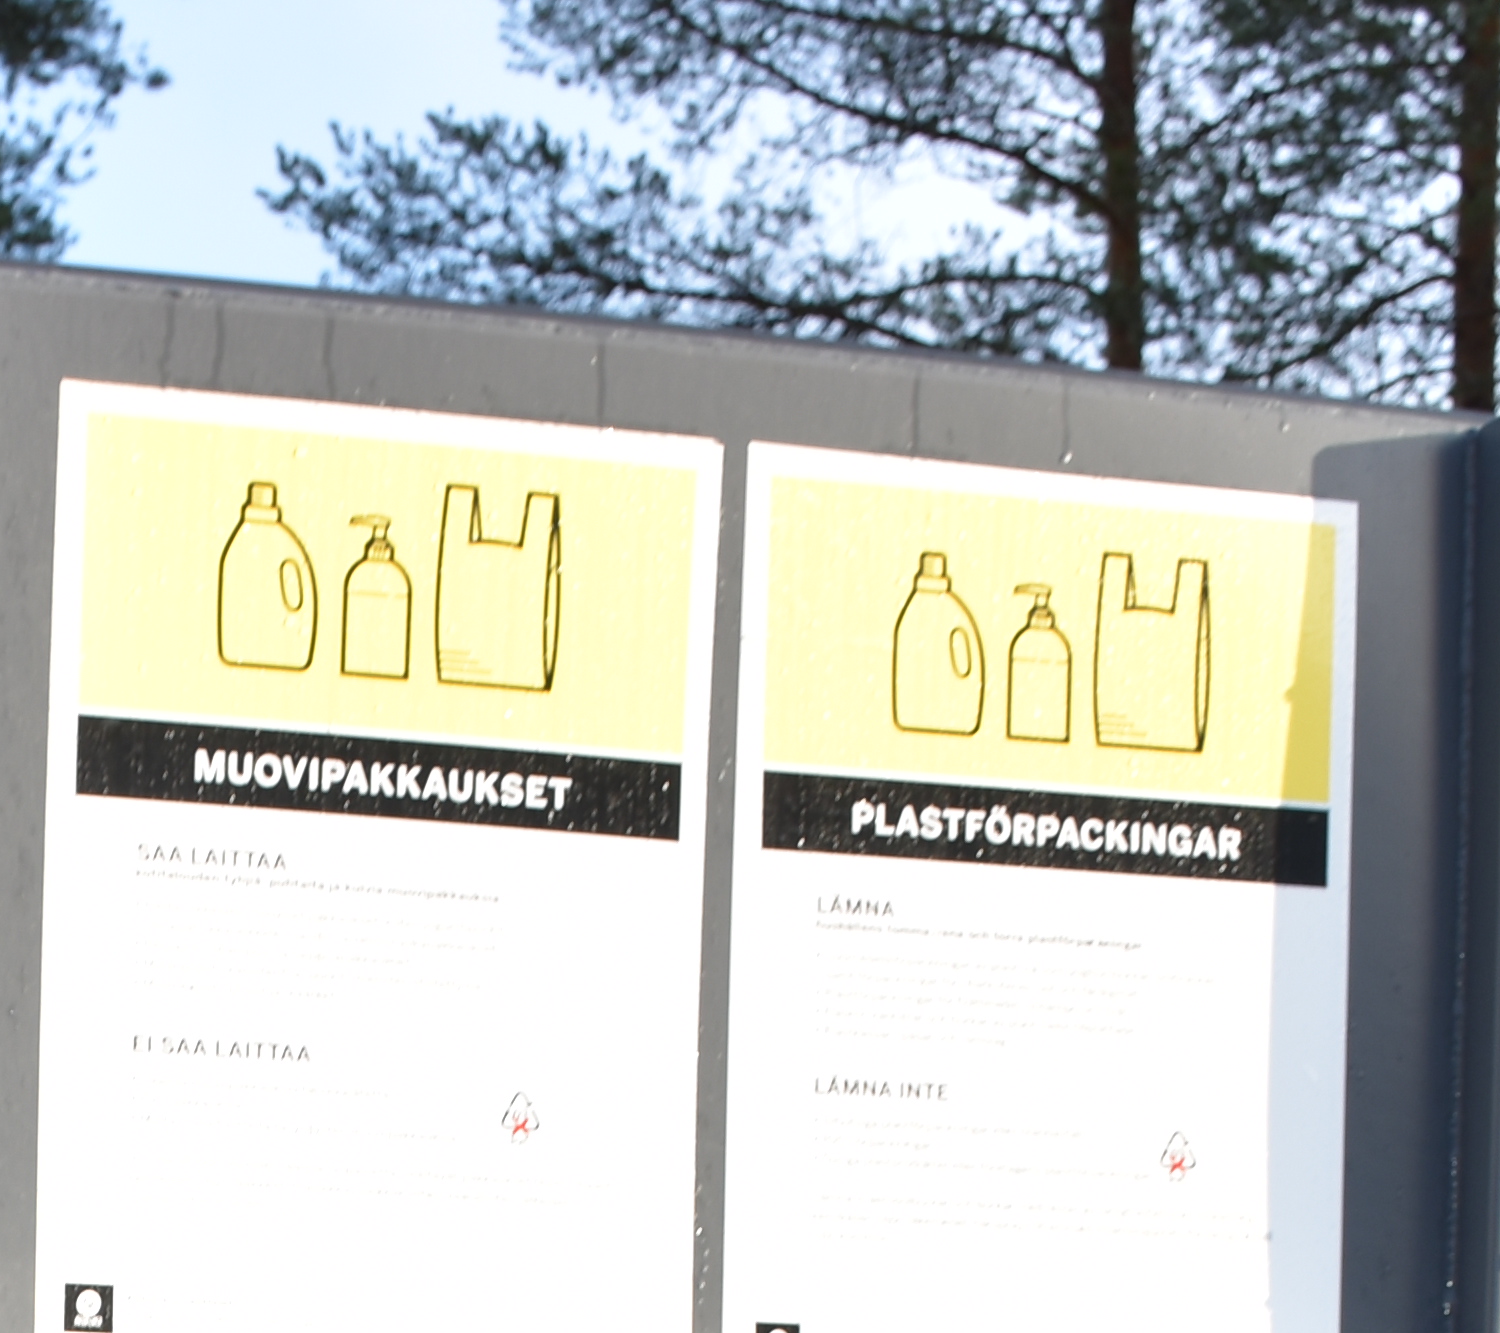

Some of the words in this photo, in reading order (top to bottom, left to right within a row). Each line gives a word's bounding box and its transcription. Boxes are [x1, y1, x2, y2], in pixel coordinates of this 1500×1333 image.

[193, 747, 573, 811] MUOVIPAKKAUKSET
[850, 799, 1243, 861] PLASTFÖRPACKINGAR
[191, 847, 286, 870] LAITTAA
[215, 1040, 311, 1062] LAITTAA
[899, 1081, 949, 1101] INTE
